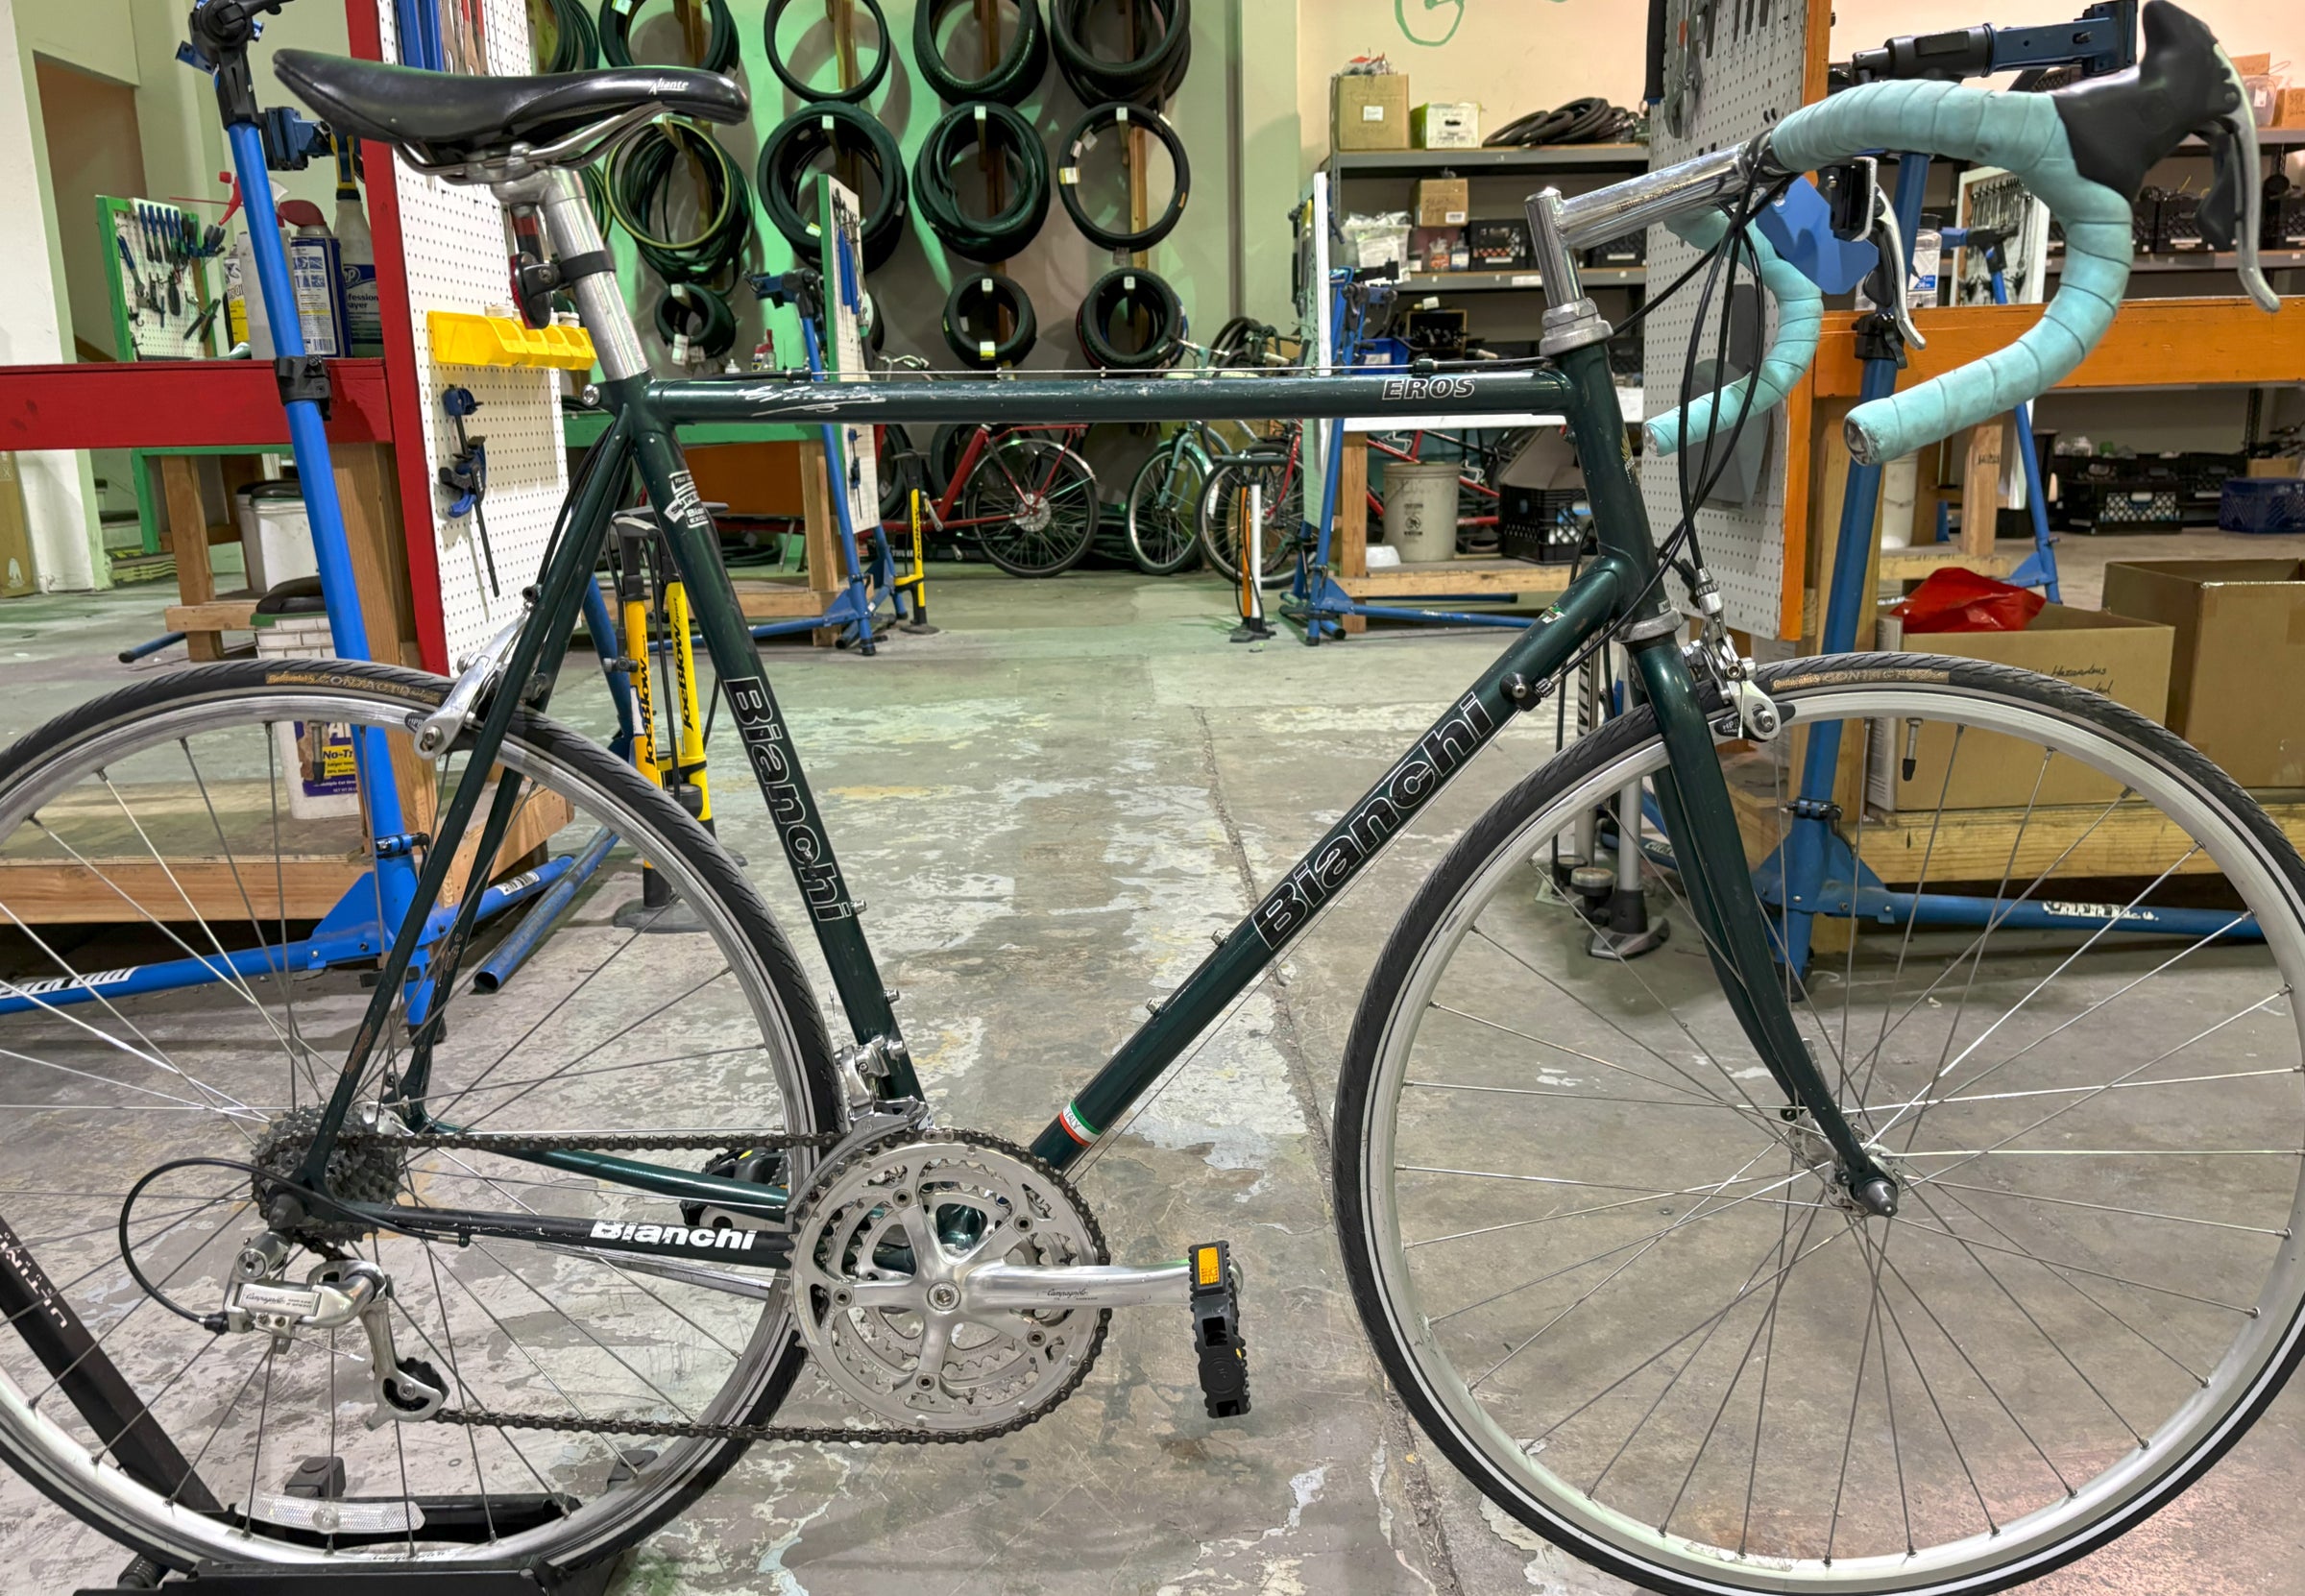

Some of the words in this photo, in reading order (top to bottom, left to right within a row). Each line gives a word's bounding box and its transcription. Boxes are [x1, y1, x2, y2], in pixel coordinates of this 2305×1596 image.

[648, 77, 689, 95] Aliante
[1382, 377, 1475, 400] EROS
[639, 658, 656, 766] JoeBlow
[673, 622, 694, 732] JoeBlow
[724, 676, 852, 921] Bianchi
[1251, 691, 1493, 951] Bianchi
[589, 1220, 758, 1250] Bianchi
